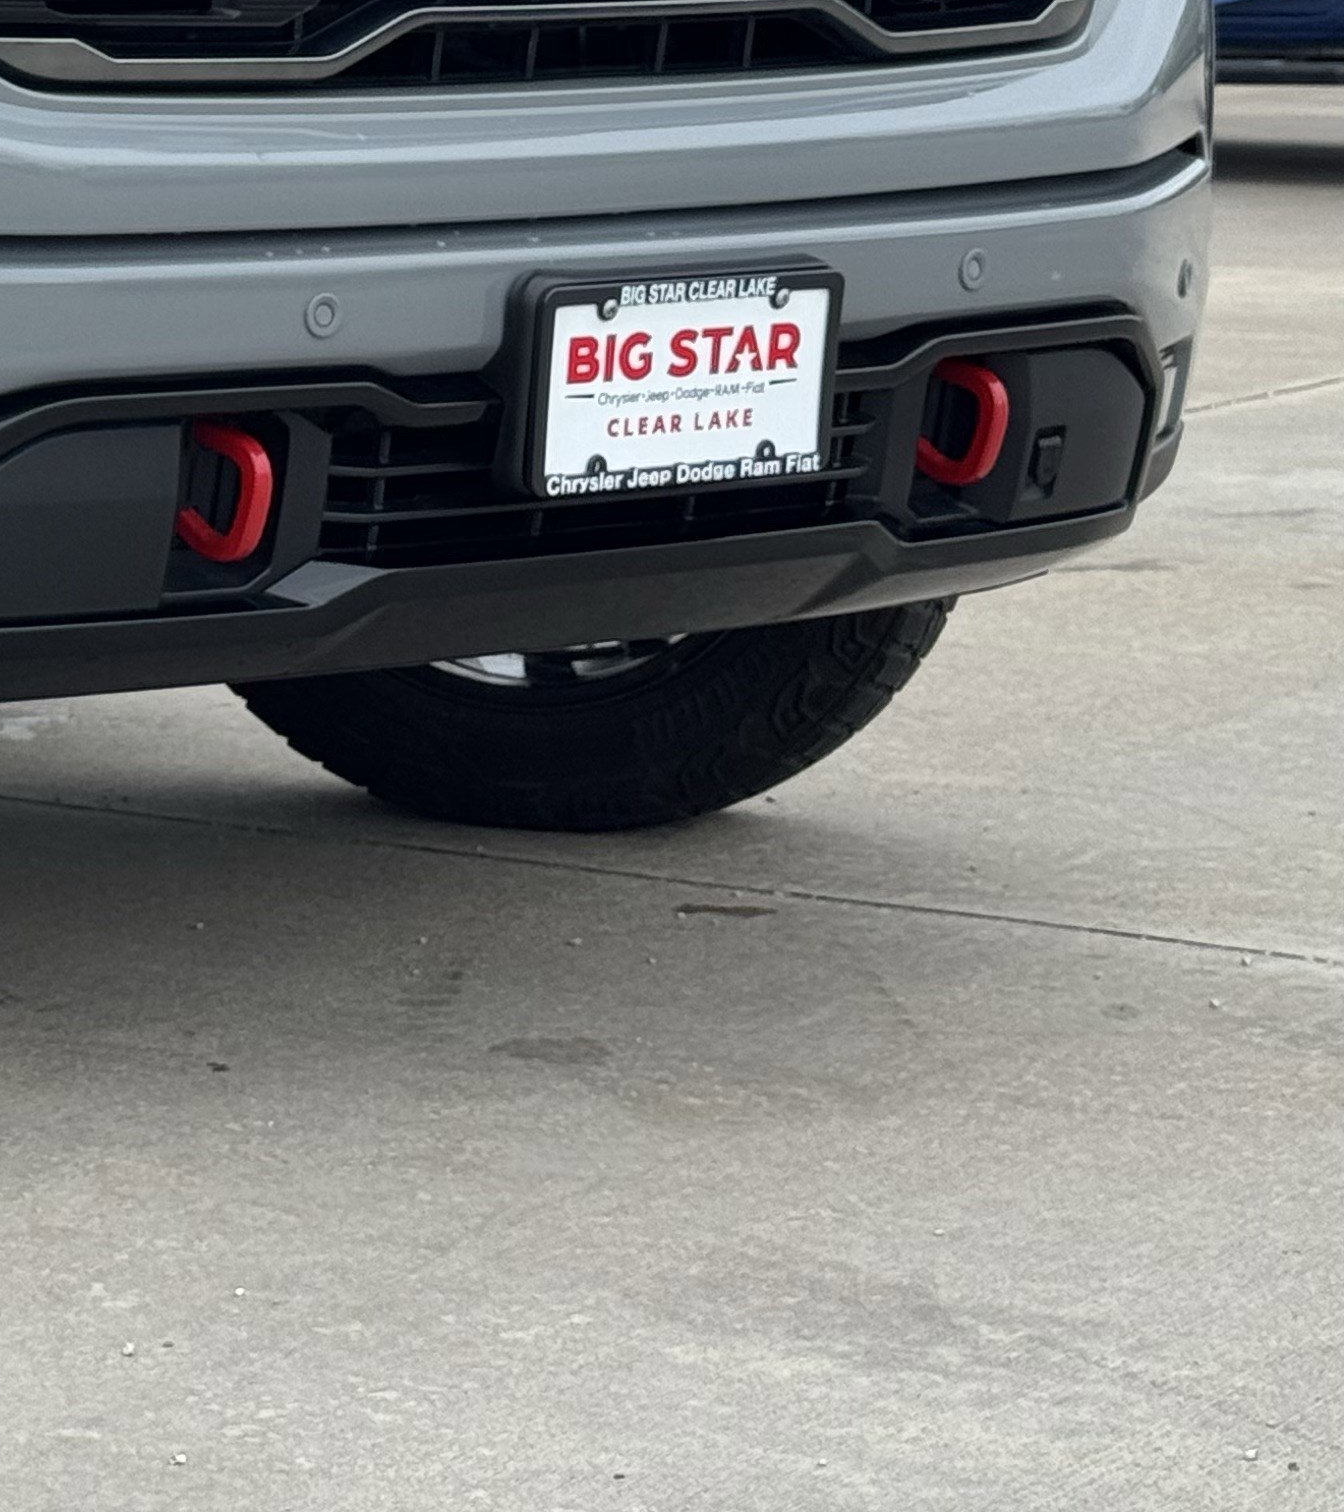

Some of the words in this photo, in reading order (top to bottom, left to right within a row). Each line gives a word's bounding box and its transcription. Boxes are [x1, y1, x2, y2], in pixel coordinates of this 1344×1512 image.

[620, 285, 645, 305] BIG
[648, 282, 686, 303] STAR
[688, 279, 736, 300] CLEAR
[738, 276, 777, 296] LAKE
[566, 331, 653, 384] BIG
[667, 322, 801, 377] STAR
[607, 414, 682, 437] CLEAR
[694, 408, 754, 431] LAKE
[546, 471, 624, 496] Chrysler
[627, 468, 671, 488] Jeep
[676, 463, 735, 484] Dodge
[740, 458, 781, 477] Ram
[786, 453, 821, 473] Fiat
